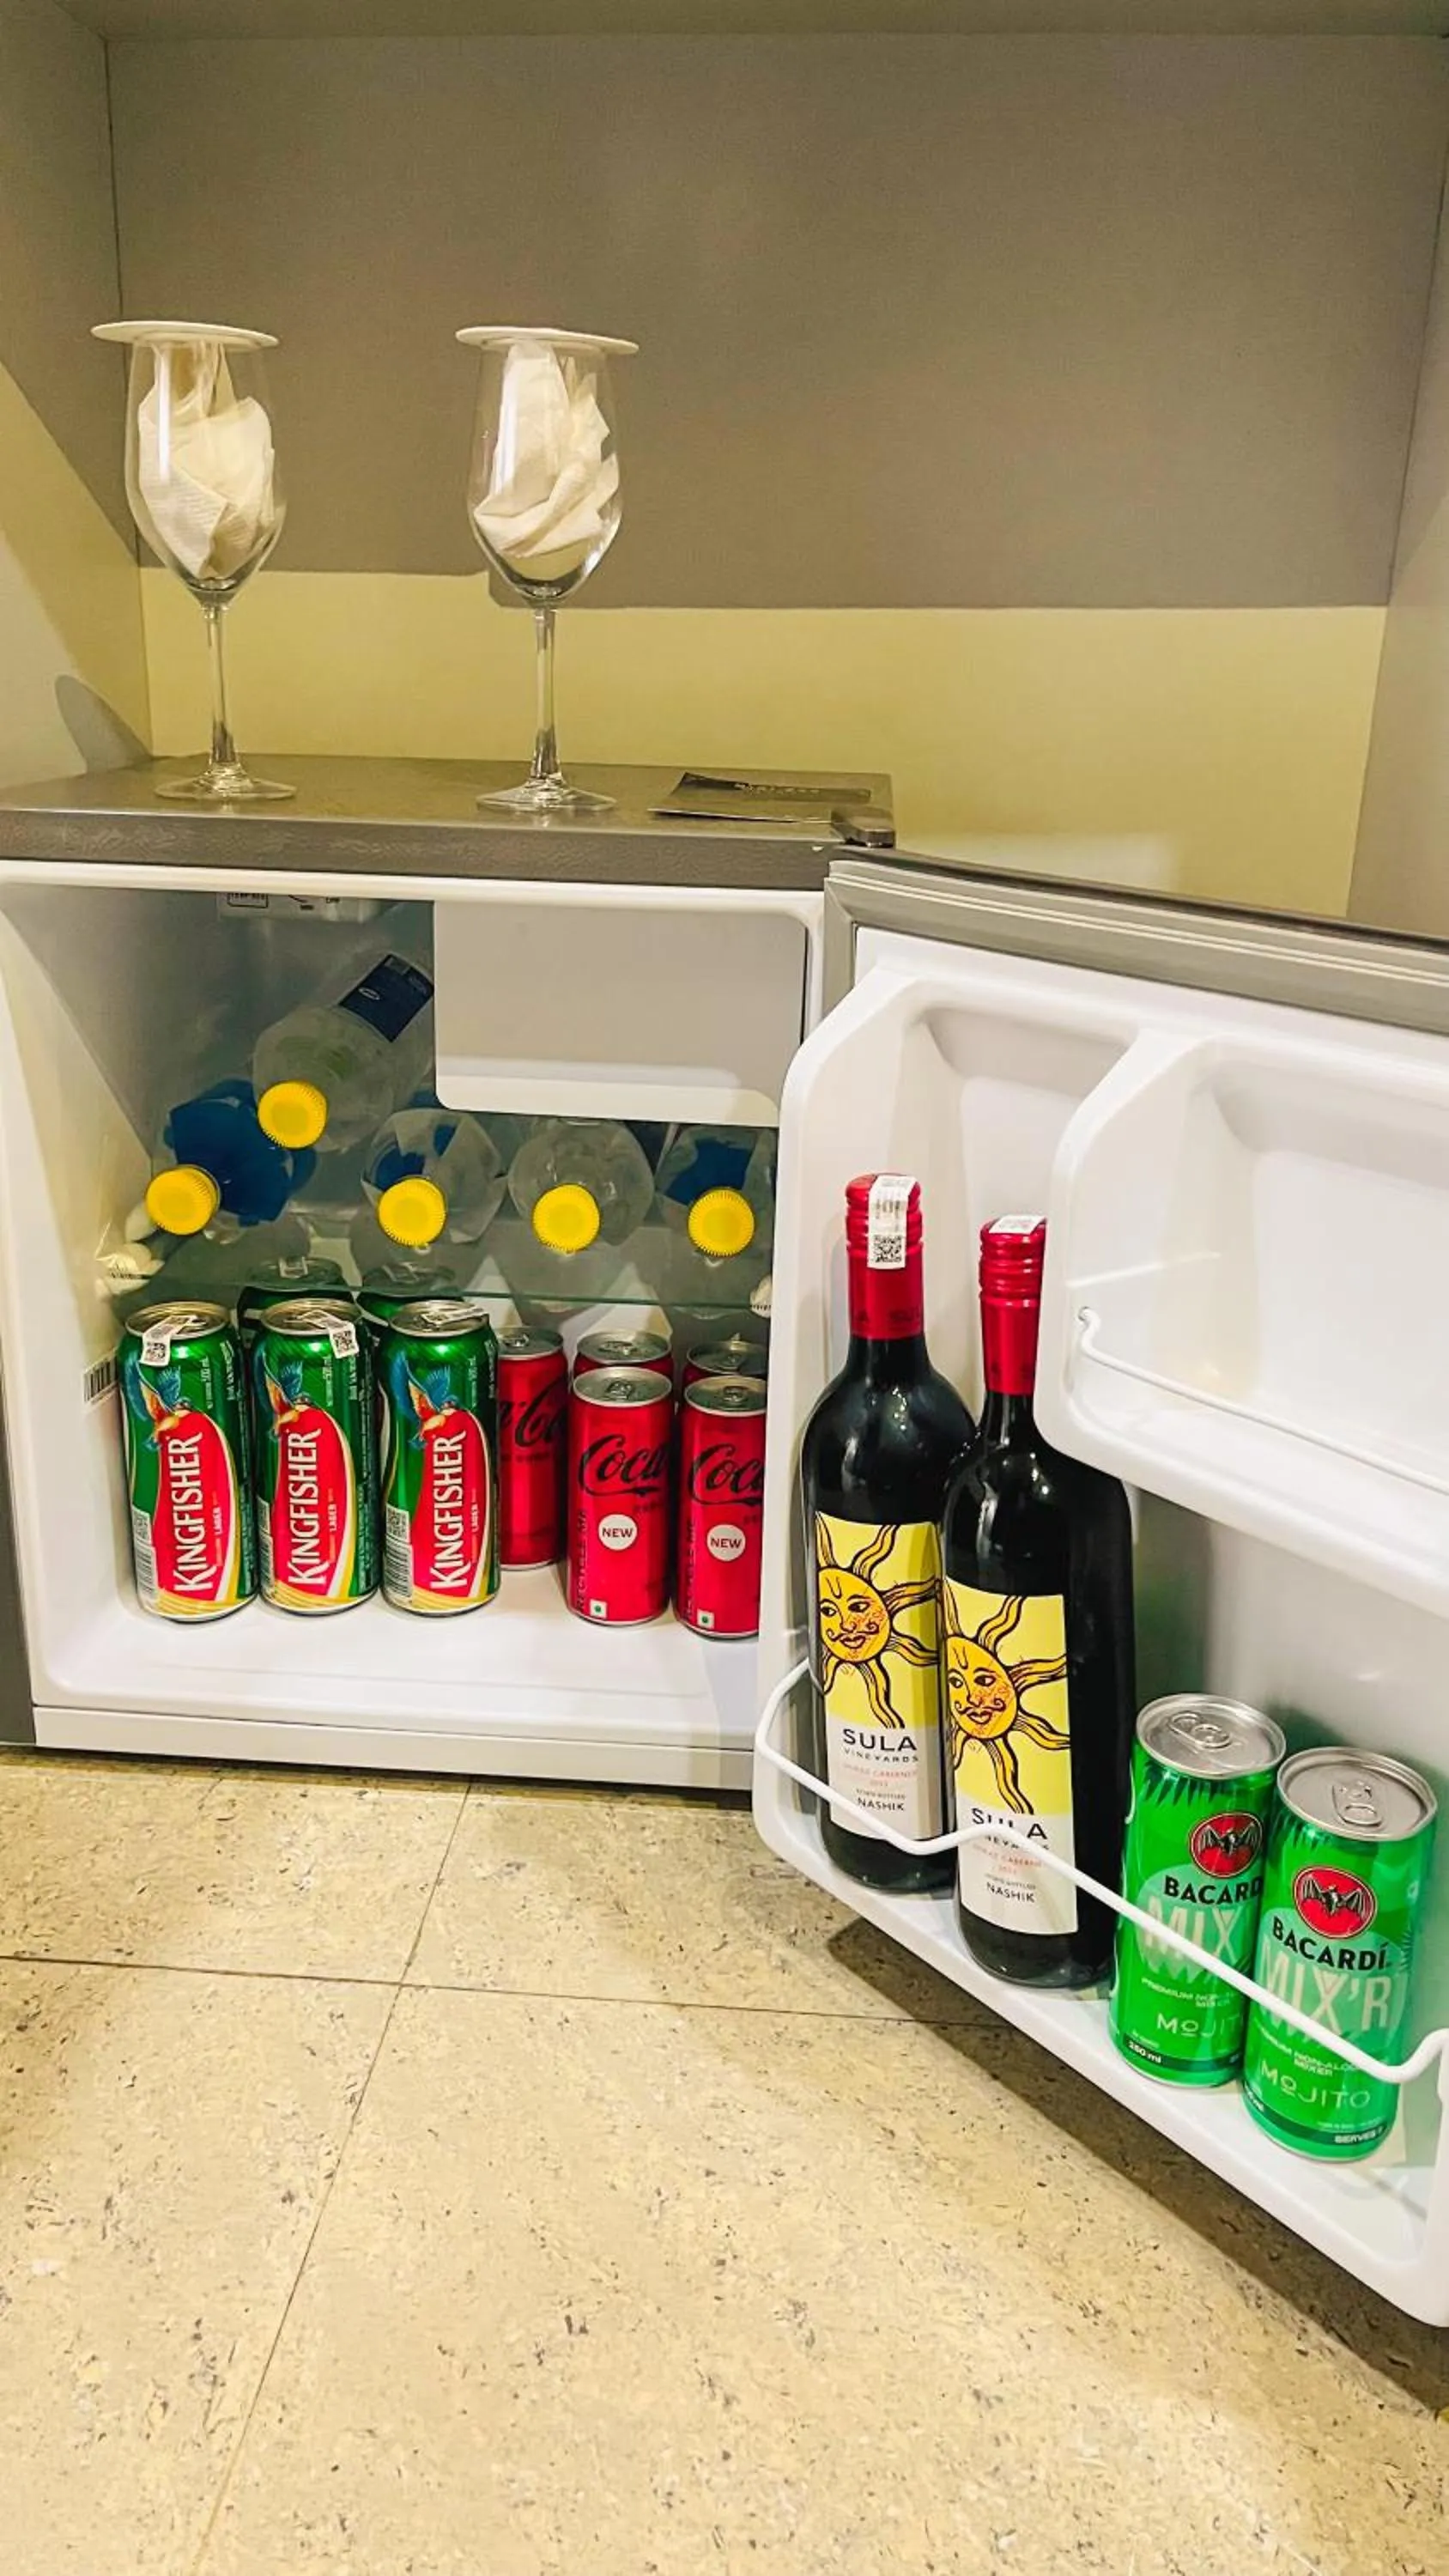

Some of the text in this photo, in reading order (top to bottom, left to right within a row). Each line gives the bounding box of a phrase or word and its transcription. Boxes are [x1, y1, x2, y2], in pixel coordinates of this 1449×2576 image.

[167, 1432, 217, 1592] KINGFISHER
[287, 1428, 330, 1585] KINGFISHER
[328, 1503, 337, 1532] LAGER
[430, 1430, 472, 1589] KINGFISHER
[602, 1527, 634, 1539] NEW
[710, 1537, 743, 1549] NEW
[843, 1728, 918, 1752] SULA
[844, 1747, 919, 1763] VINEYARDS
[858, 1796, 905, 1811] NASHIK
[986, 1881, 1035, 1904] NASHIK
[1164, 1874, 1264, 1905] BACARD
[1258, 1933, 1392, 2036] MIX'R
